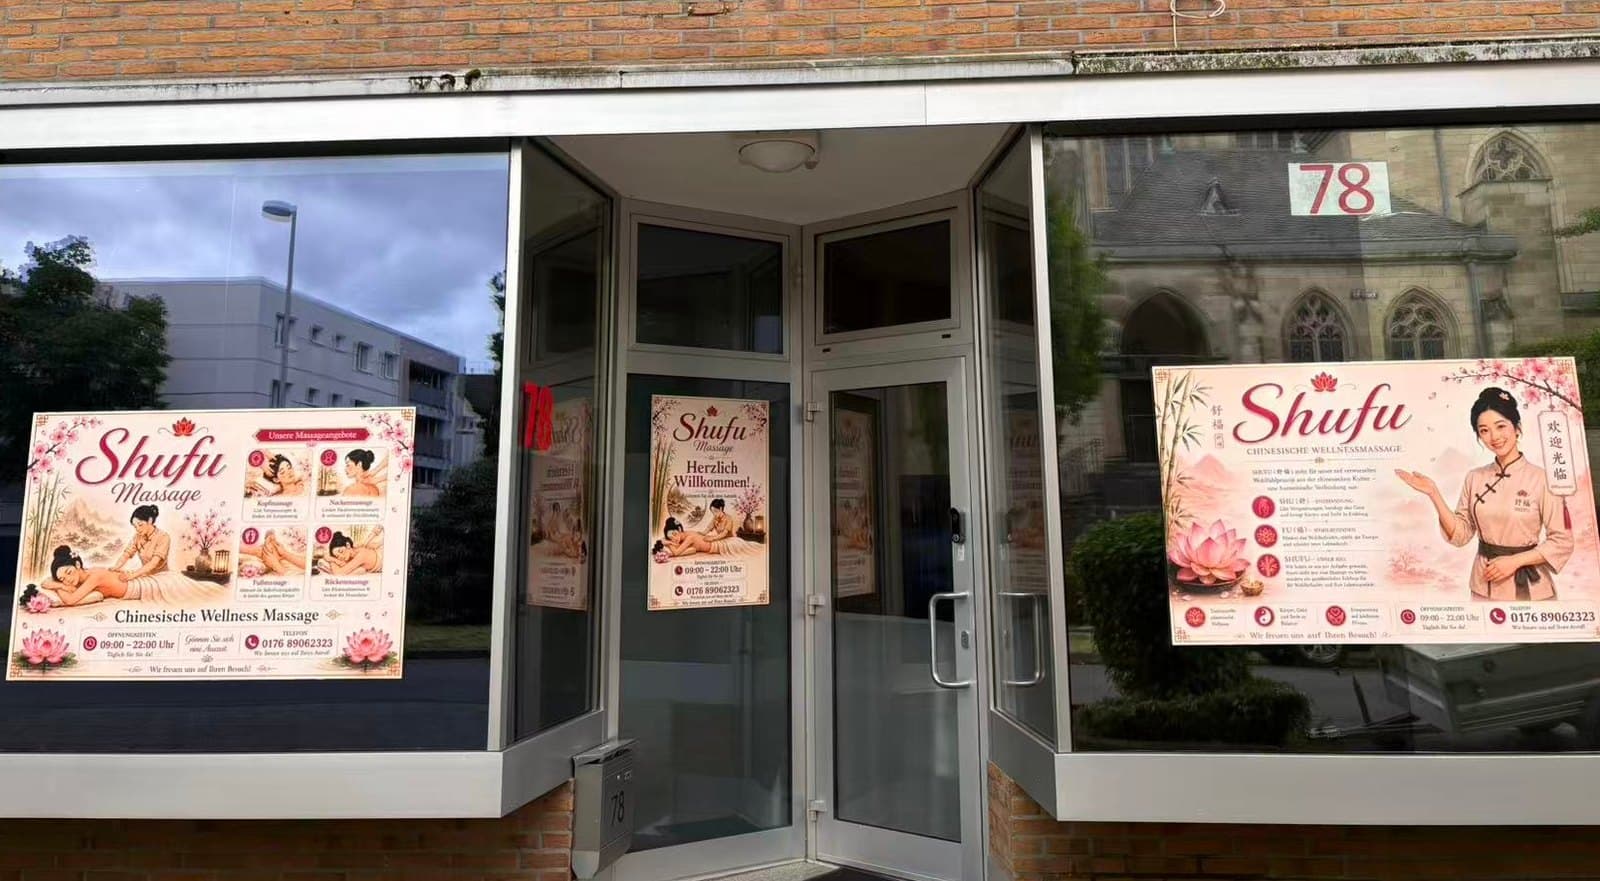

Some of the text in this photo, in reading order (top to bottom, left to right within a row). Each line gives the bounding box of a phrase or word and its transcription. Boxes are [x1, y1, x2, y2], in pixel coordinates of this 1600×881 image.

[1300, 163, 1374, 214] 78
[521, 382, 553, 452] 78
[1232, 383, 1412, 444] Shufu
[268, 431, 357, 441] Unsere Massageangebote
[673, 413, 747, 444] Shufu
[694, 440, 734, 454] Massage
[1246, 446, 1402, 455] CHINESISCHE WELLNESSMASSAGE
[1547, 420, 1567, 480] 欢迎光临
[75, 427, 226, 487] Shufu
[687, 461, 738, 474] Herzlich
[674, 475, 750, 488] Willkommen!
[111, 482, 201, 510] Massage
[686, 586, 739, 595] 0176 89062323
[115, 608, 320, 625] Chinesische Wellness Massage
[1510, 612, 1595, 623] 0176 89062323
[100, 641, 124, 649] 09:00
[133, 640, 157, 649] 22:00
[159, 640, 175, 649] Uhr
[262, 638, 333, 648] 0176 89062323
[611, 791, 624, 826] 78
